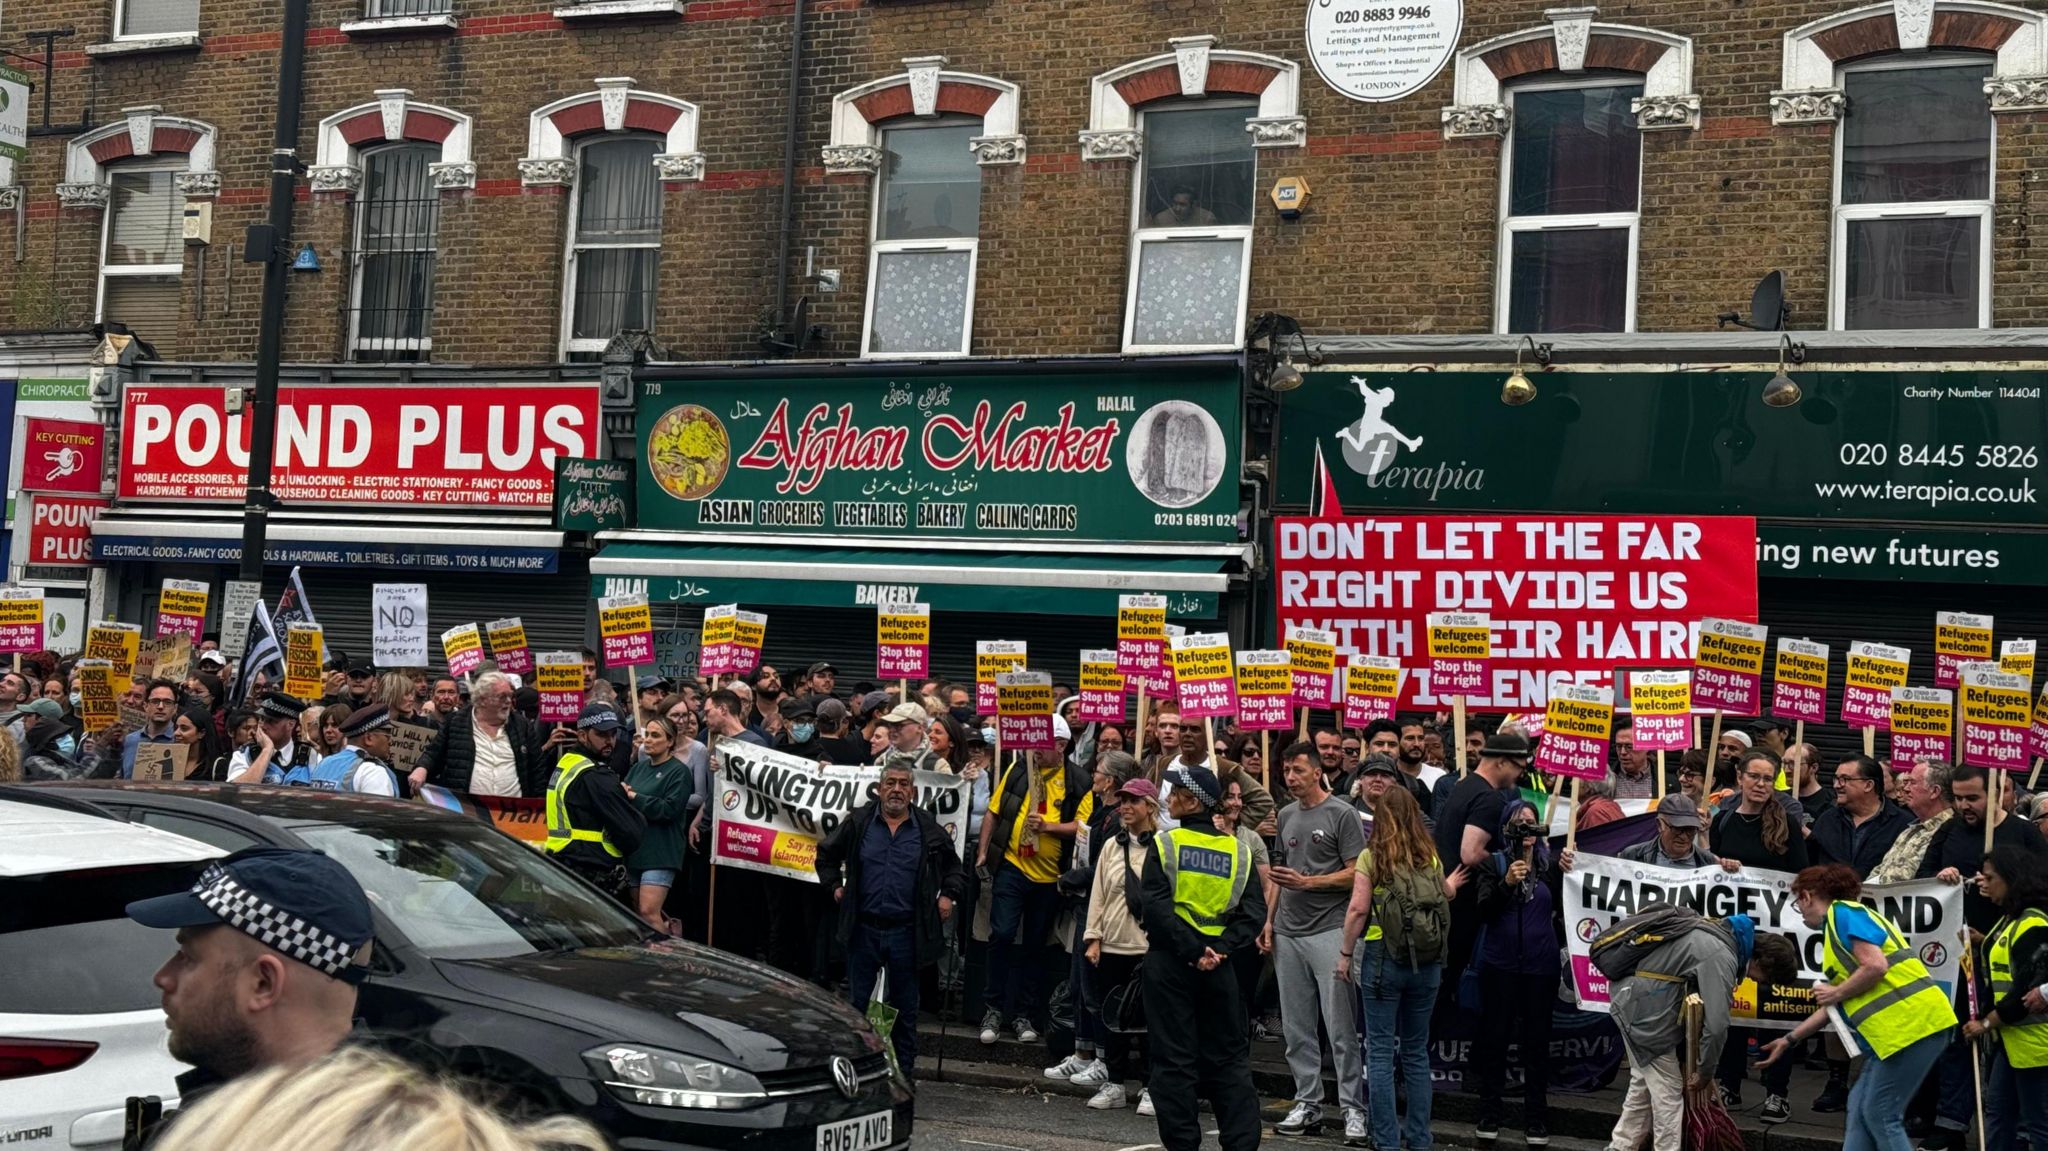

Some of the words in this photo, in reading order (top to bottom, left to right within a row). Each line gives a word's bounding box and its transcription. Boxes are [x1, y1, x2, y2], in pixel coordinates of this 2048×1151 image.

[1335, 10, 1360, 24] 020
[1362, 8, 1395, 22] 8883
[1398, 5, 1431, 20] 9946
[1326, 36, 1361, 46] Lettings
[1363, 34, 1380, 43] and
[1382, 32, 1440, 42] Management
[1365, 47, 1387, 56] quality
[1394, 57, 1431, 66] Residential
[1360, 82, 1401, 90] LONDON
[1278, 188, 1296, 198] ADT
[130, 392, 148, 402] 777
[645, 384, 662, 395] 779
[1904, 387, 1944, 400] Charity
[1948, 387, 1992, 398] Number
[1999, 388, 2040, 398] 1144041
[730, 400, 762, 420] حلال
[1097, 396, 1136, 412] HALAL
[36, 432, 54, 443] KEY
[56, 434, 95, 446] CUTTING
[398, 404, 584, 472] PLUS
[737, 398, 908, 494] Afghan
[921, 399, 1120, 472] Market
[1840, 443, 1888, 466] 020
[1898, 444, 1964, 467] 8445
[1976, 446, 2038, 468] 5826
[562, 460, 594, 482] Afghan
[1366, 438, 1485, 500] terapia
[134, 473, 168, 484] MOBILE
[170, 474, 236, 486] ACCESSORIES,
[280, 476, 286, 484] &
[288, 476, 345, 486] UNLOCKING
[353, 477, 400, 488] ELECTRIC
[402, 478, 463, 488] STATIONERY
[472, 478, 504, 490] FANCY
[506, 479, 542, 490] GOODS
[136, 486, 187, 496] HARDWARE
[330, 488, 379, 500] CLEANING
[380, 490, 414, 500] GOODS
[423, 490, 442, 501] KEY
[446, 490, 490, 502] CUTTING
[499, 492, 532, 503] WATCH
[1815, 478, 2037, 508] www.terapia.co.uk
[698, 500, 753, 524] ASIAN
[758, 500, 826, 527] GROCERIES
[834, 502, 908, 528] VEGETABLES
[916, 502, 967, 528] BAKERY
[976, 504, 1031, 530] CALLING
[1032, 504, 1078, 531] CARDS
[1154, 513, 1182, 526] 0203
[1186, 514, 1214, 527] 6891
[1216, 514, 1238, 528] 024
[1280, 519, 1402, 560] DON'T
[1416, 522, 1502, 560] LET
[1516, 522, 1604, 560] THE
[1618, 522, 1700, 560] FAR
[102, 545, 151, 556] ELECTRICAL
[152, 546, 183, 558] GOODS
[188, 548, 215, 558] FANCY
[280, 551, 286, 560] &
[288, 550, 339, 562] HARDWARE
[346, 552, 394, 564] TOILETRIES
[401, 554, 421, 565] GIFT
[423, 554, 448, 566] ITEMS
[456, 556, 478, 567] TOYS
[480, 556, 487, 567] &
[490, 556, 514, 568] MUCH
[518, 558, 544, 568] MORE
[1812, 544, 1876, 564] new
[1886, 539, 2000, 568] futures
[163, 590, 205, 604] Refugees
[669, 580, 710, 600] حلال
[856, 584, 920, 604] BAKERY
[1282, 570, 1422, 608] RIGHT
[1435, 572, 1616, 609] DIVIDE
[1629, 572, 1688, 609] US
[162, 601, 202, 613] welcome
[379, 605, 414, 630] NO
[602, 608, 648, 624] Refugees
[1120, 610, 1164, 625] Refugees
[604, 620, 646, 632] welcome
[880, 616, 927, 632] Refugees
[1120, 624, 1162, 636] welcome
[91, 630, 124, 644] SMASH
[605, 636, 630, 650] Stop
[630, 634, 647, 645] the
[880, 628, 924, 641] welcome
[1434, 628, 1487, 644] Refugees
[88, 645, 129, 659] FASCISM
[374, 648, 422, 656] THUGGERY
[606, 649, 621, 660] far
[623, 645, 648, 660] right
[880, 646, 902, 659] Stop
[904, 646, 922, 658] the
[1434, 642, 1485, 655] welcome
[1702, 635, 1762, 656] Refugees
[880, 658, 894, 670] far
[896, 658, 922, 672] right
[1433, 660, 1460, 674] Stop
[1462, 661, 1482, 672] the
[1700, 652, 1756, 669] welcome
[81, 670, 107, 680] SMASH
[293, 666, 321, 679] RACISM
[539, 666, 582, 680] Refugees
[1239, 667, 1289, 682] Refugees
[1696, 668, 1730, 684] Stop
[1733, 674, 1752, 688] the
[540, 678, 580, 688] welcome
[1240, 680, 1287, 691] welcome
[1433, 674, 1450, 686] far
[1454, 674, 1482, 689] right
[82, 685, 112, 697] FASCISM
[1000, 686, 1050, 702] Refugees
[1966, 688, 2028, 708] Refugees
[84, 702, 90, 712] &
[92, 701, 118, 712] RACISM
[1000, 700, 1048, 712] welcome
[1966, 706, 2026, 722] welcome
[1001, 716, 1026, 730] Stop
[1030, 716, 1048, 728] the
[1002, 728, 1018, 740] far
[1022, 729, 1048, 744] right
[724, 752, 860, 811] ISLINGTON
[744, 789, 778, 823] UP
[781, 802, 817, 834] TO
[726, 826, 762, 844] Refugees
[726, 842, 759, 856] welcome
[786, 838, 804, 850] Say
[1181, 849, 1230, 874] POLICE
[1772, 984, 1815, 1002] Stamp
[824, 1122, 860, 1151] RV67
[864, 1116, 887, 1147] AVO
